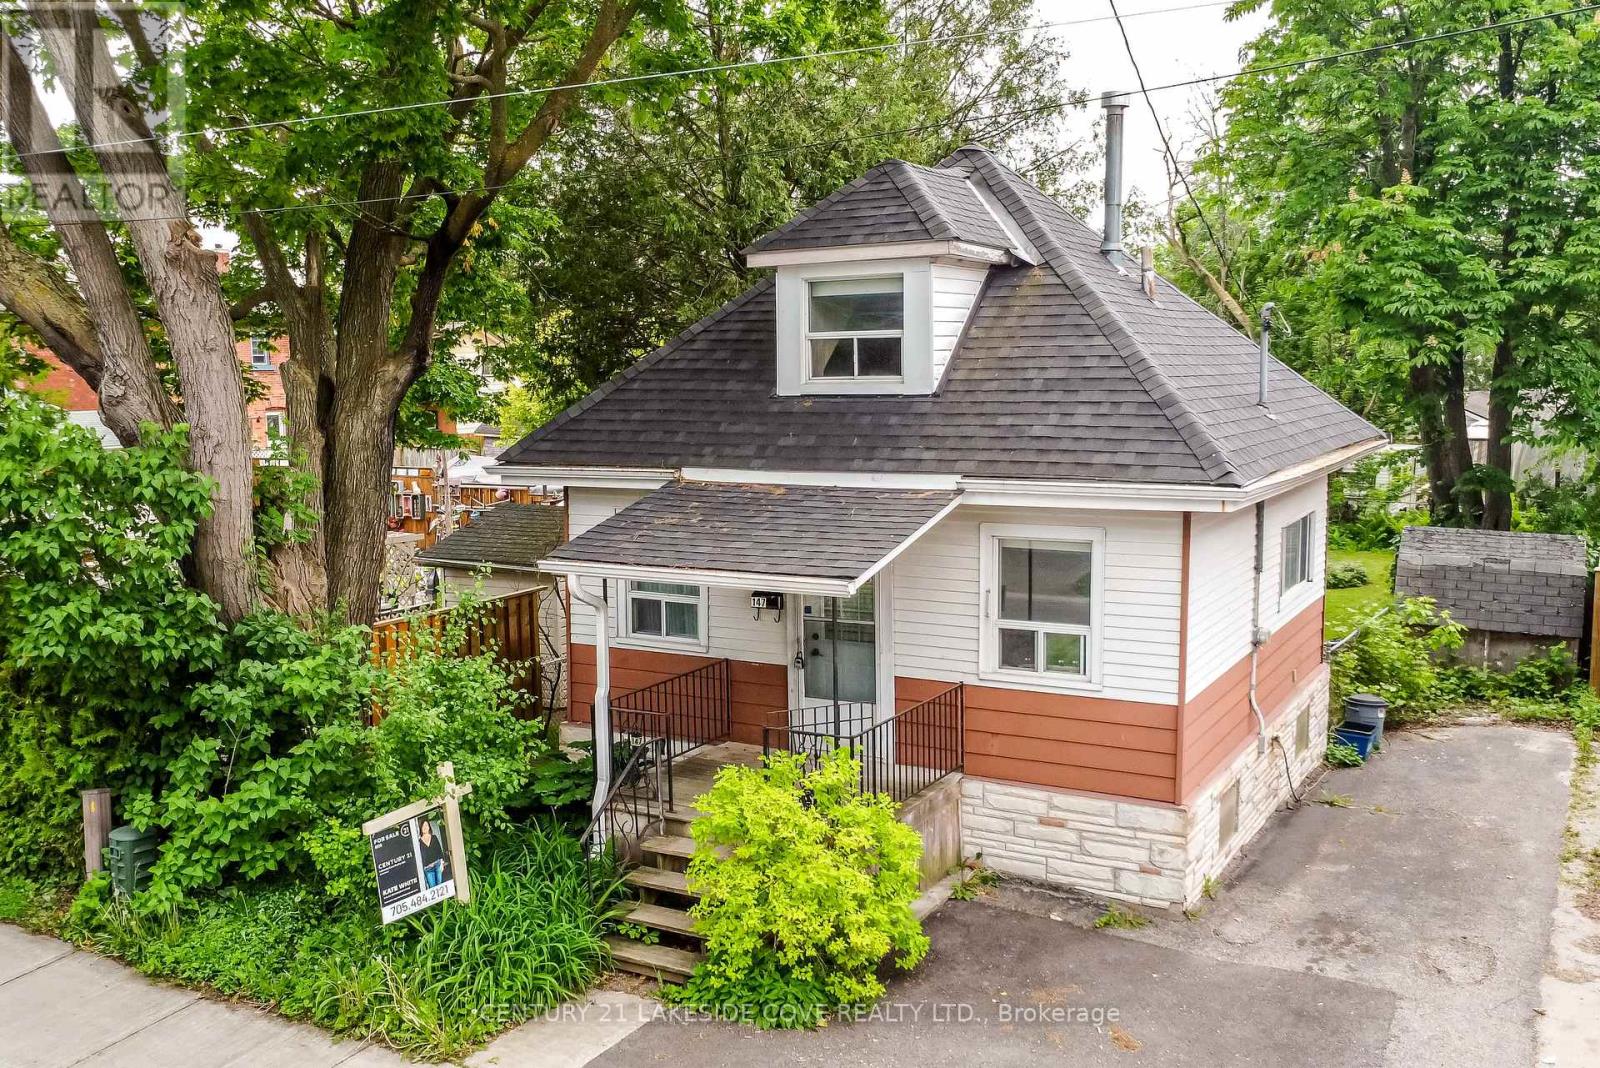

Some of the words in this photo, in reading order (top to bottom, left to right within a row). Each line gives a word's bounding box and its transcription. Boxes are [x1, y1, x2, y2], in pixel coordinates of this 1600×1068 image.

[752, 598, 766, 606] 147
[373, 836, 385, 845] FOR
[385, 830, 399, 840] SALE
[378, 854, 405, 869] CENTURY
[382, 884, 398, 896] KATE
[398, 877, 418, 890] WHITE
[390, 885, 449, 917] 705.484.2121
